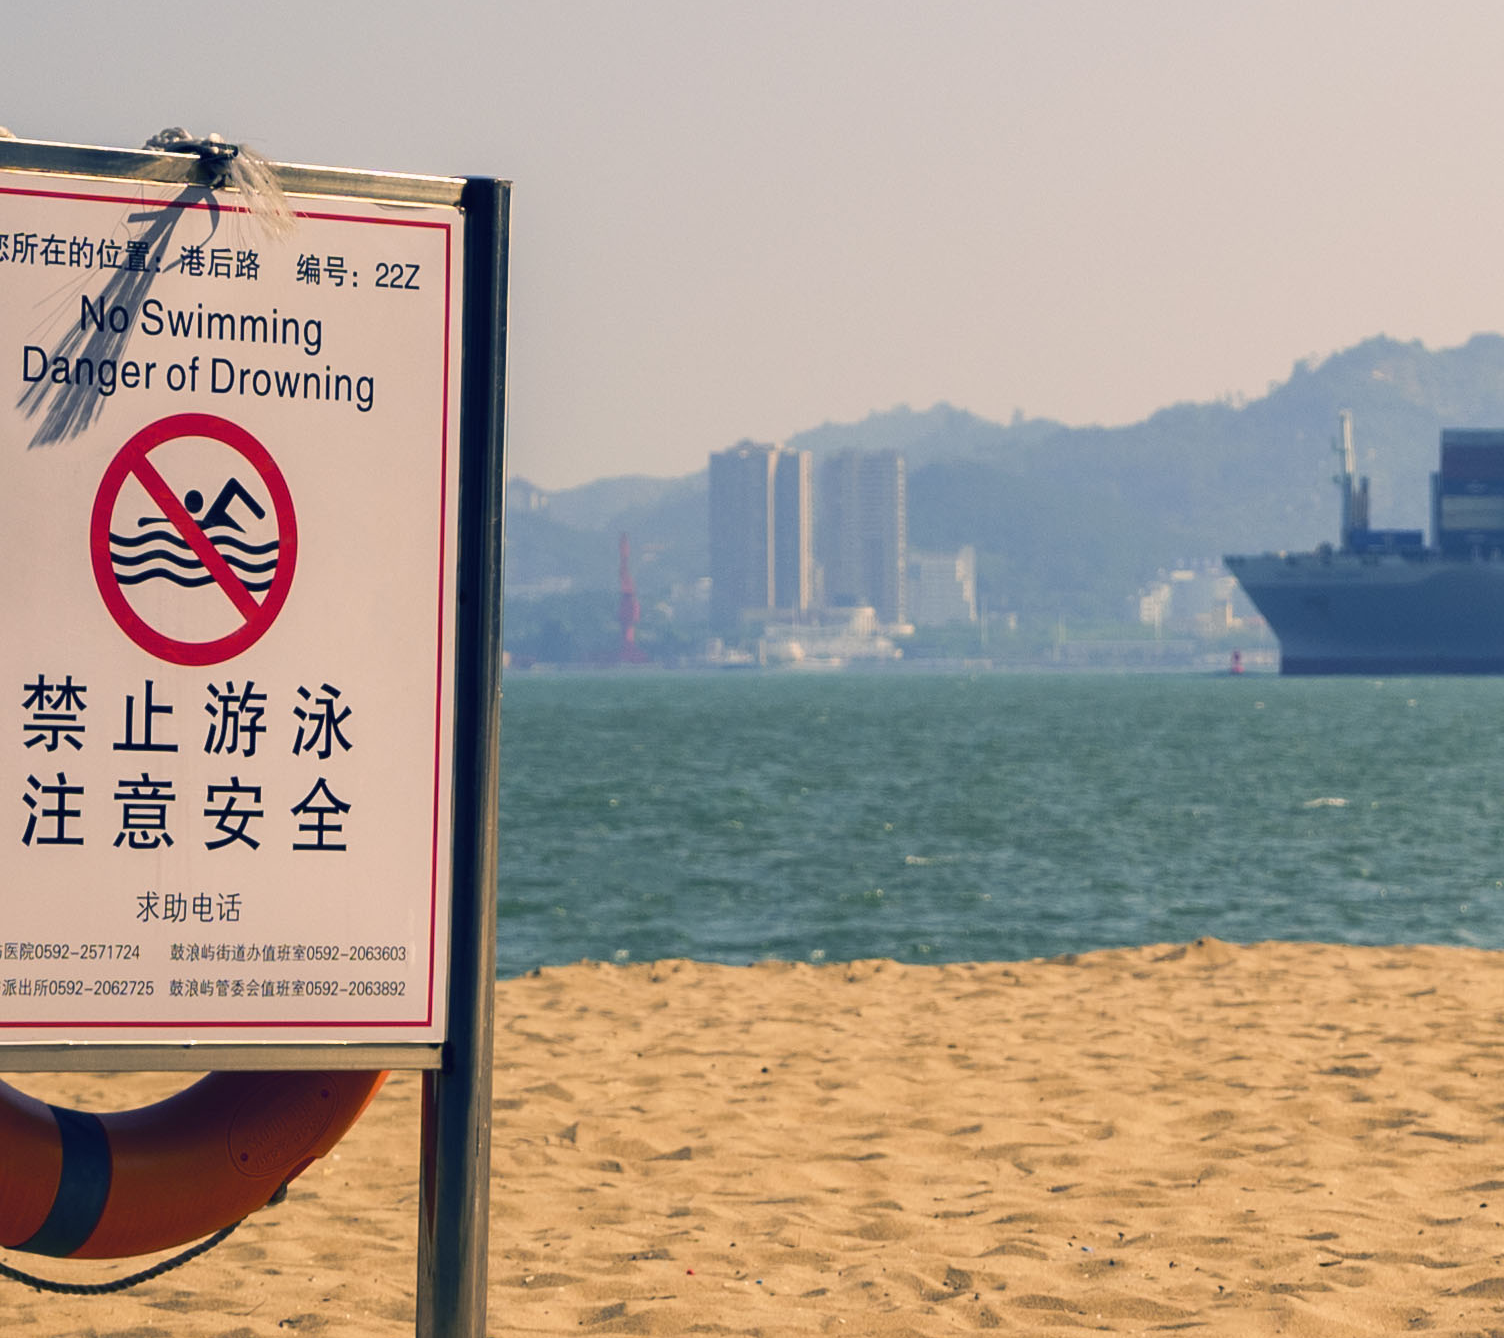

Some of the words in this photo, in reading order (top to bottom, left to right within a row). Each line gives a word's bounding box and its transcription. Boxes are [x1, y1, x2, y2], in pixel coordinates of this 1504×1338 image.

[80, 294, 130, 334] No
[141, 298, 323, 356] Swimming
[22, 345, 157, 397] Danger
[166, 355, 200, 393] of
[210, 357, 375, 413] Drowning
[21, 673, 354, 760] 禁止游泳
[21, 771, 352, 852] 注意安全
[136, 890, 243, 923] 求助电话
